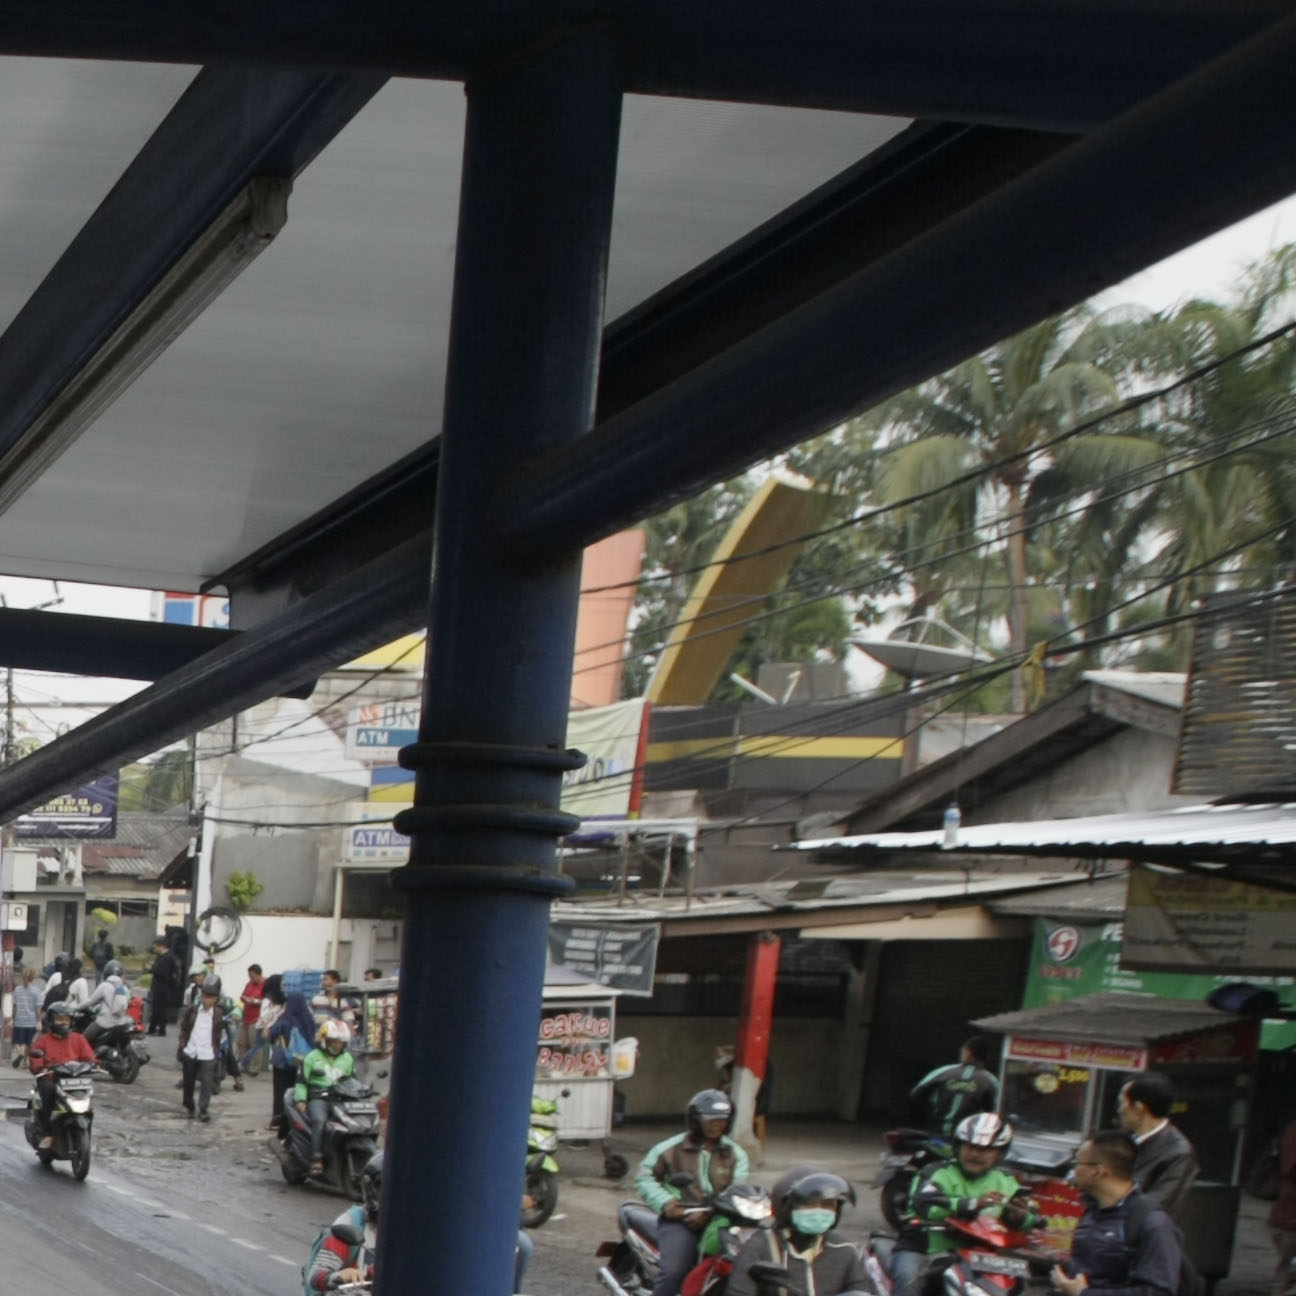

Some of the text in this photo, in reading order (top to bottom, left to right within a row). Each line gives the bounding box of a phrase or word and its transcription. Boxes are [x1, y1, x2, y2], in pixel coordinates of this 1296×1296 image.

[384, 705, 417, 728] BN
[358, 730, 389, 745] ATM
[355, 830, 391, 846] ATM
